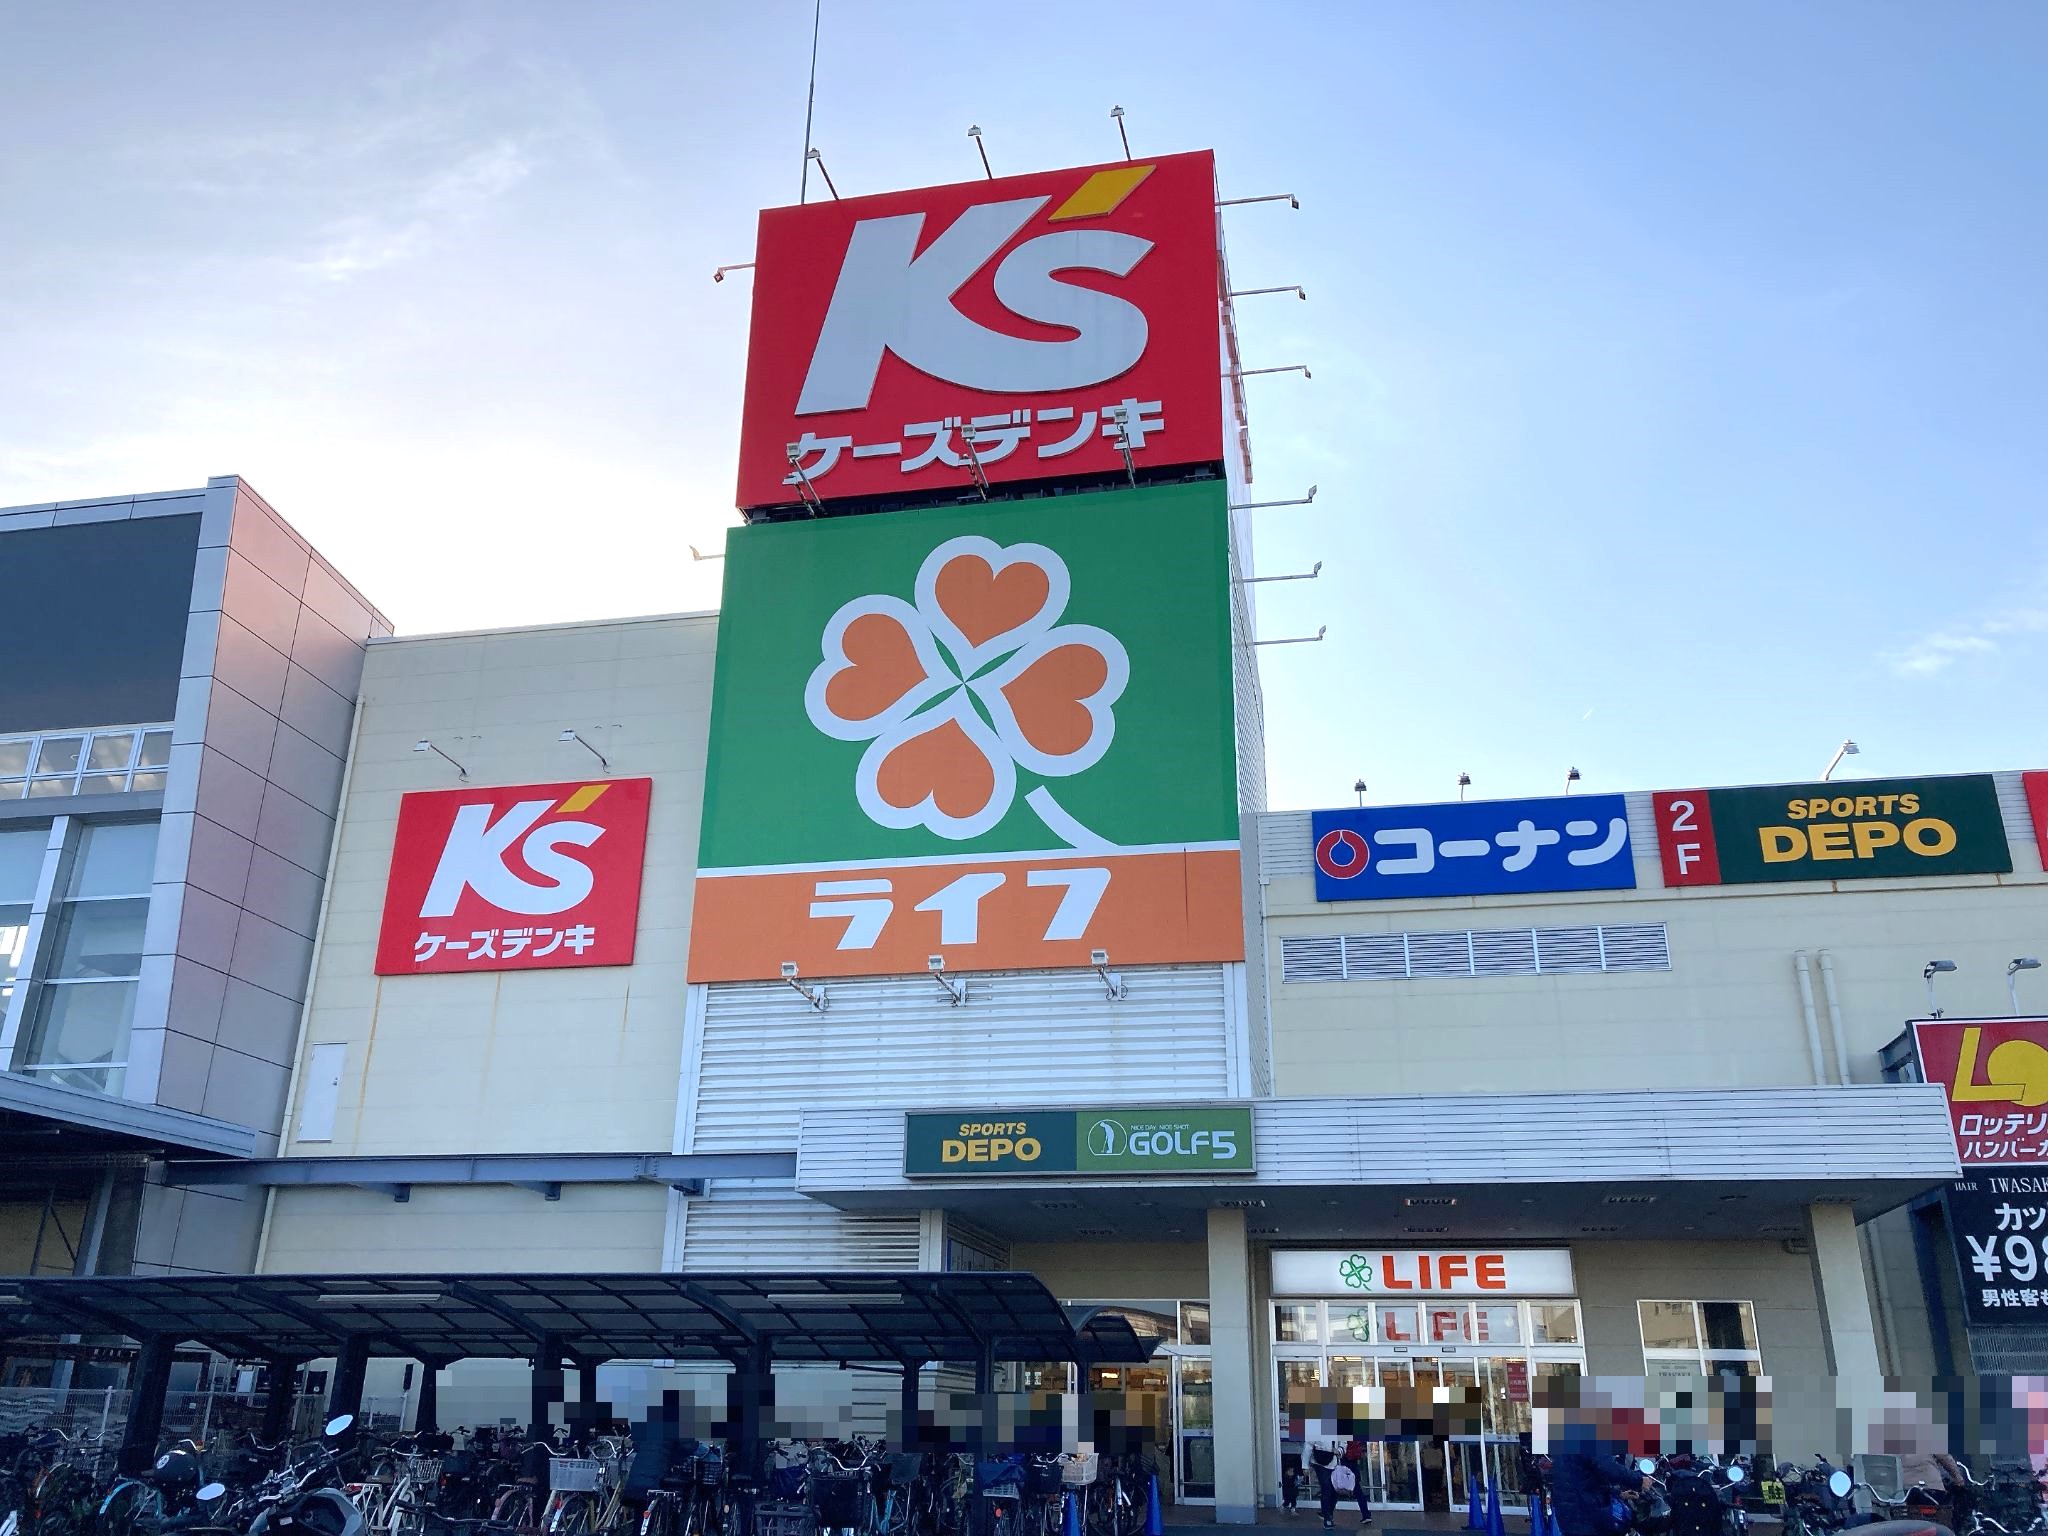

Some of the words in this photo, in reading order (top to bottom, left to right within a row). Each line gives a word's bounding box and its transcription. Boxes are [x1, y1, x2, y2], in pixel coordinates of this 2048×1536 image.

[783, 398, 1165, 485] ケーズデンキ
[1787, 794, 1920, 820] SPORTS
[1374, 816, 1627, 875] コーナン
[1758, 818, 1957, 863] DEPO
[809, 867, 1111, 951] ライフ
[414, 924, 595, 963] ケーズデンキ
[958, 1122, 1027, 1136] SPORTS
[1959, 1113, 2048, 1135] ロッテリ
[941, 1138, 1042, 1164] DEPO
[1955, 1182, 1978, 1192] HAIR
[1994, 1202, 2048, 1231] カッ
[1381, 1255, 1507, 1290] LIFE
[1965, 1235, 2048, 1282] ¥9
